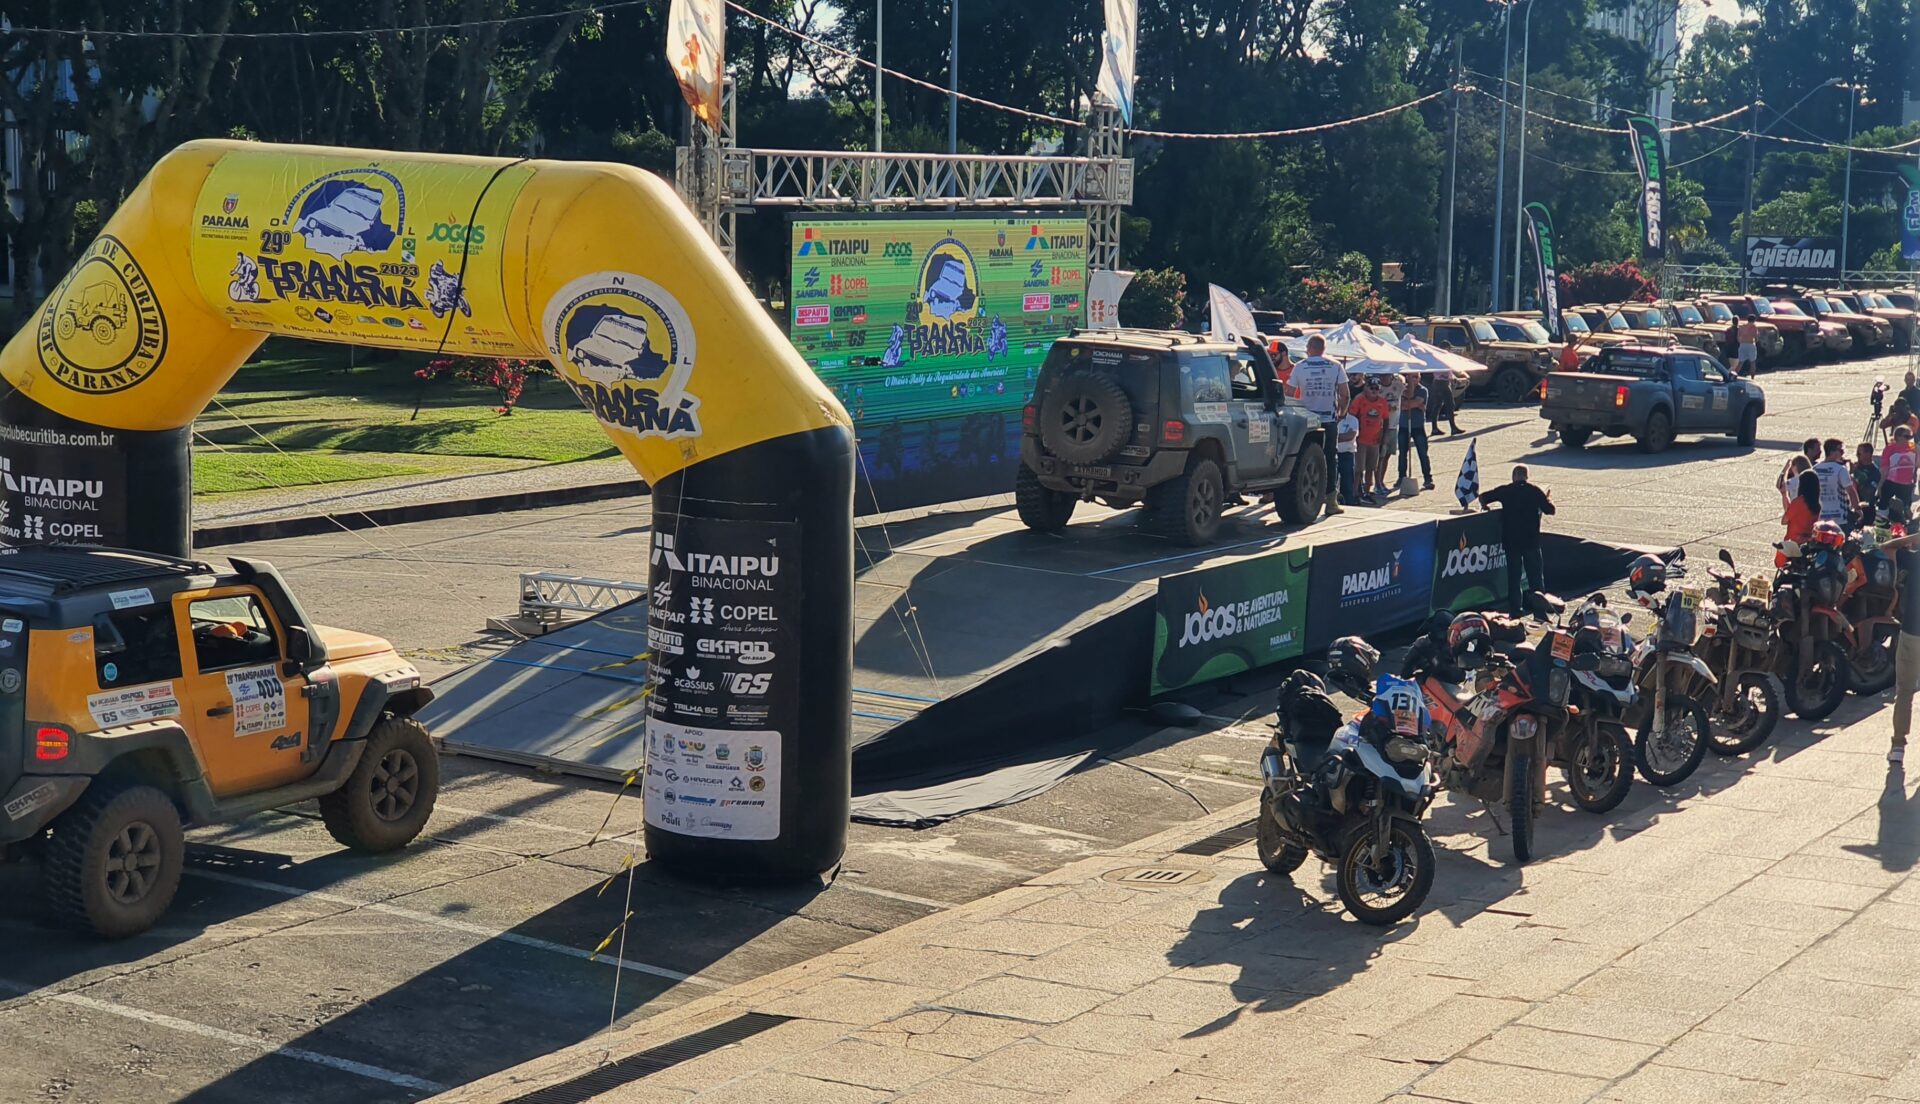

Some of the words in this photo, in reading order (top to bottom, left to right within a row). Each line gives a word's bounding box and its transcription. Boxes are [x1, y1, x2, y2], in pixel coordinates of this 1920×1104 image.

[202, 215, 249, 229] PARANÁ
[408, 227, 415, 235] L
[427, 222, 485, 244] JOGOS
[828, 239, 869, 255] ITAIPU
[882, 242, 912, 258] JOGOS
[1050, 235, 1083, 249] ITAIPU
[831, 256, 867, 267] BINACIONAL
[989, 247, 1014, 258] PARANÁ
[1750, 248, 1836, 269] CHEGADA
[257, 255, 384, 288] TRANS
[381, 263, 419, 277] 2023
[613, 277, 625, 285] N
[796, 289, 828, 299] SANEPAR
[845, 277, 869, 290] COPEL
[1024, 279, 1049, 288] SANEPAR
[1062, 269, 1082, 281] COPEL
[102, 240, 118, 261] DE
[123, 263, 161, 361] CURITIBA
[271, 277, 428, 312] PARANÁ
[904, 321, 968, 341] TRANS
[683, 356, 692, 365] L
[56, 360, 141, 389] PARANÁ
[0, 424, 115, 446] pclubecuritiba.com.br
[20, 475, 103, 498] ITAIPU
[24, 496, 100, 511] BINACIONAL
[49, 523, 103, 538] COPEL
[687, 552, 779, 577] ITAIPU
[1441, 544, 1488, 579] JOGOS
[1489, 544, 1499, 556] DE
[691, 575, 774, 591] BINACIONAL
[1341, 562, 1390, 596] PARANÁ
[1683, 597, 1693, 606] 10
[649, 605, 686, 624] SANEPAR
[720, 605, 778, 621] COPEL
[1178, 603, 1237, 649] JOGOS
[1237, 602, 1249, 617] DE
[1249, 589, 1289, 615] AVENTURA
[1235, 617, 1243, 634] &
[1243, 606, 1282, 632] NATUREZA
[1269, 632, 1292, 647] PARANÁ
[256, 677, 282, 699] 404
[730, 672, 773, 694] GS
[246, 703, 262, 713] COPEL
[1391, 692, 1418, 713] 131
[102, 711, 118, 723] GS
